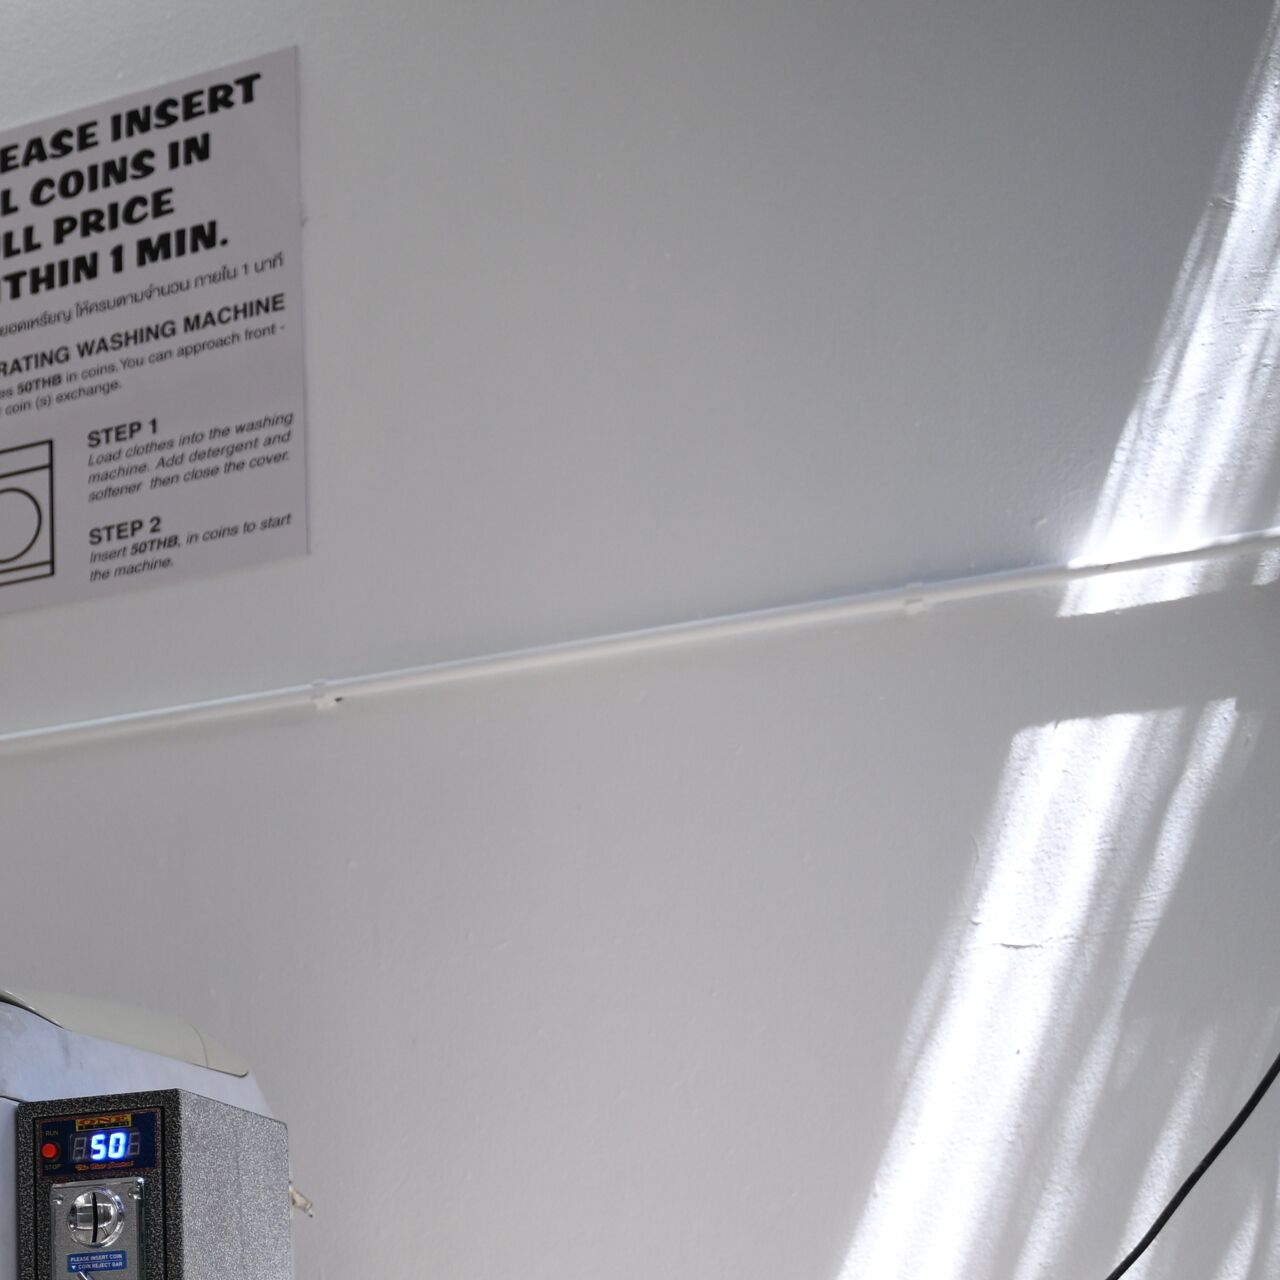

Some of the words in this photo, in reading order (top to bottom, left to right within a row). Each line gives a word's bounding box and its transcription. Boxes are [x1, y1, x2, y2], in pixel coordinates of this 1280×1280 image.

[110, 72, 262, 142] INSERT
[29, 149, 156, 207] COINS
[168, 131, 211, 171] IN
[53, 186, 175, 246] PRICE
[110, 244, 124, 274] 1
[136, 219, 229, 268] MIN.
[76, 319, 177, 359] WASHING
[183, 292, 286, 334] MACHINE
[17, 373, 63, 396] 50THB
[65, 372, 78, 383] in
[119, 356, 145, 370] You
[147, 349, 173, 364] can
[176, 332, 241, 359] approach
[244, 323, 276, 341] front
[4, 400, 32, 415] coin
[55, 380, 122, 404] exchange.
[87, 420, 143, 449] STEP
[148, 417, 157, 435] 1
[87, 448, 122, 467] Load
[125, 438, 175, 458] clothes
[178, 432, 205, 447] into
[208, 426, 231, 441] the
[234, 412, 294, 435] washing
[87, 463, 151, 484] machine.
[155, 452, 185, 470] Add
[188, 437, 260, 463] detergent
[262, 429, 292, 448] and
[88, 481, 143, 503] softener
[150, 474, 180, 489] then
[182, 465, 220, 483] close
[223, 460, 246, 474] the
[248, 450, 291, 469] cover.
[88, 519, 144, 546] STEP
[149, 515, 161, 534] 2
[89, 546, 127, 564] Insert
[185, 533, 200, 545] in
[202, 525, 239, 542] coins
[242, 521, 257, 534] to
[259, 513, 292, 531] start
[89, 568, 111, 583] the
[113, 557, 176, 577] machine.
[45, 1129, 59, 1137] RUN
[91, 1132, 127, 1160] 50
